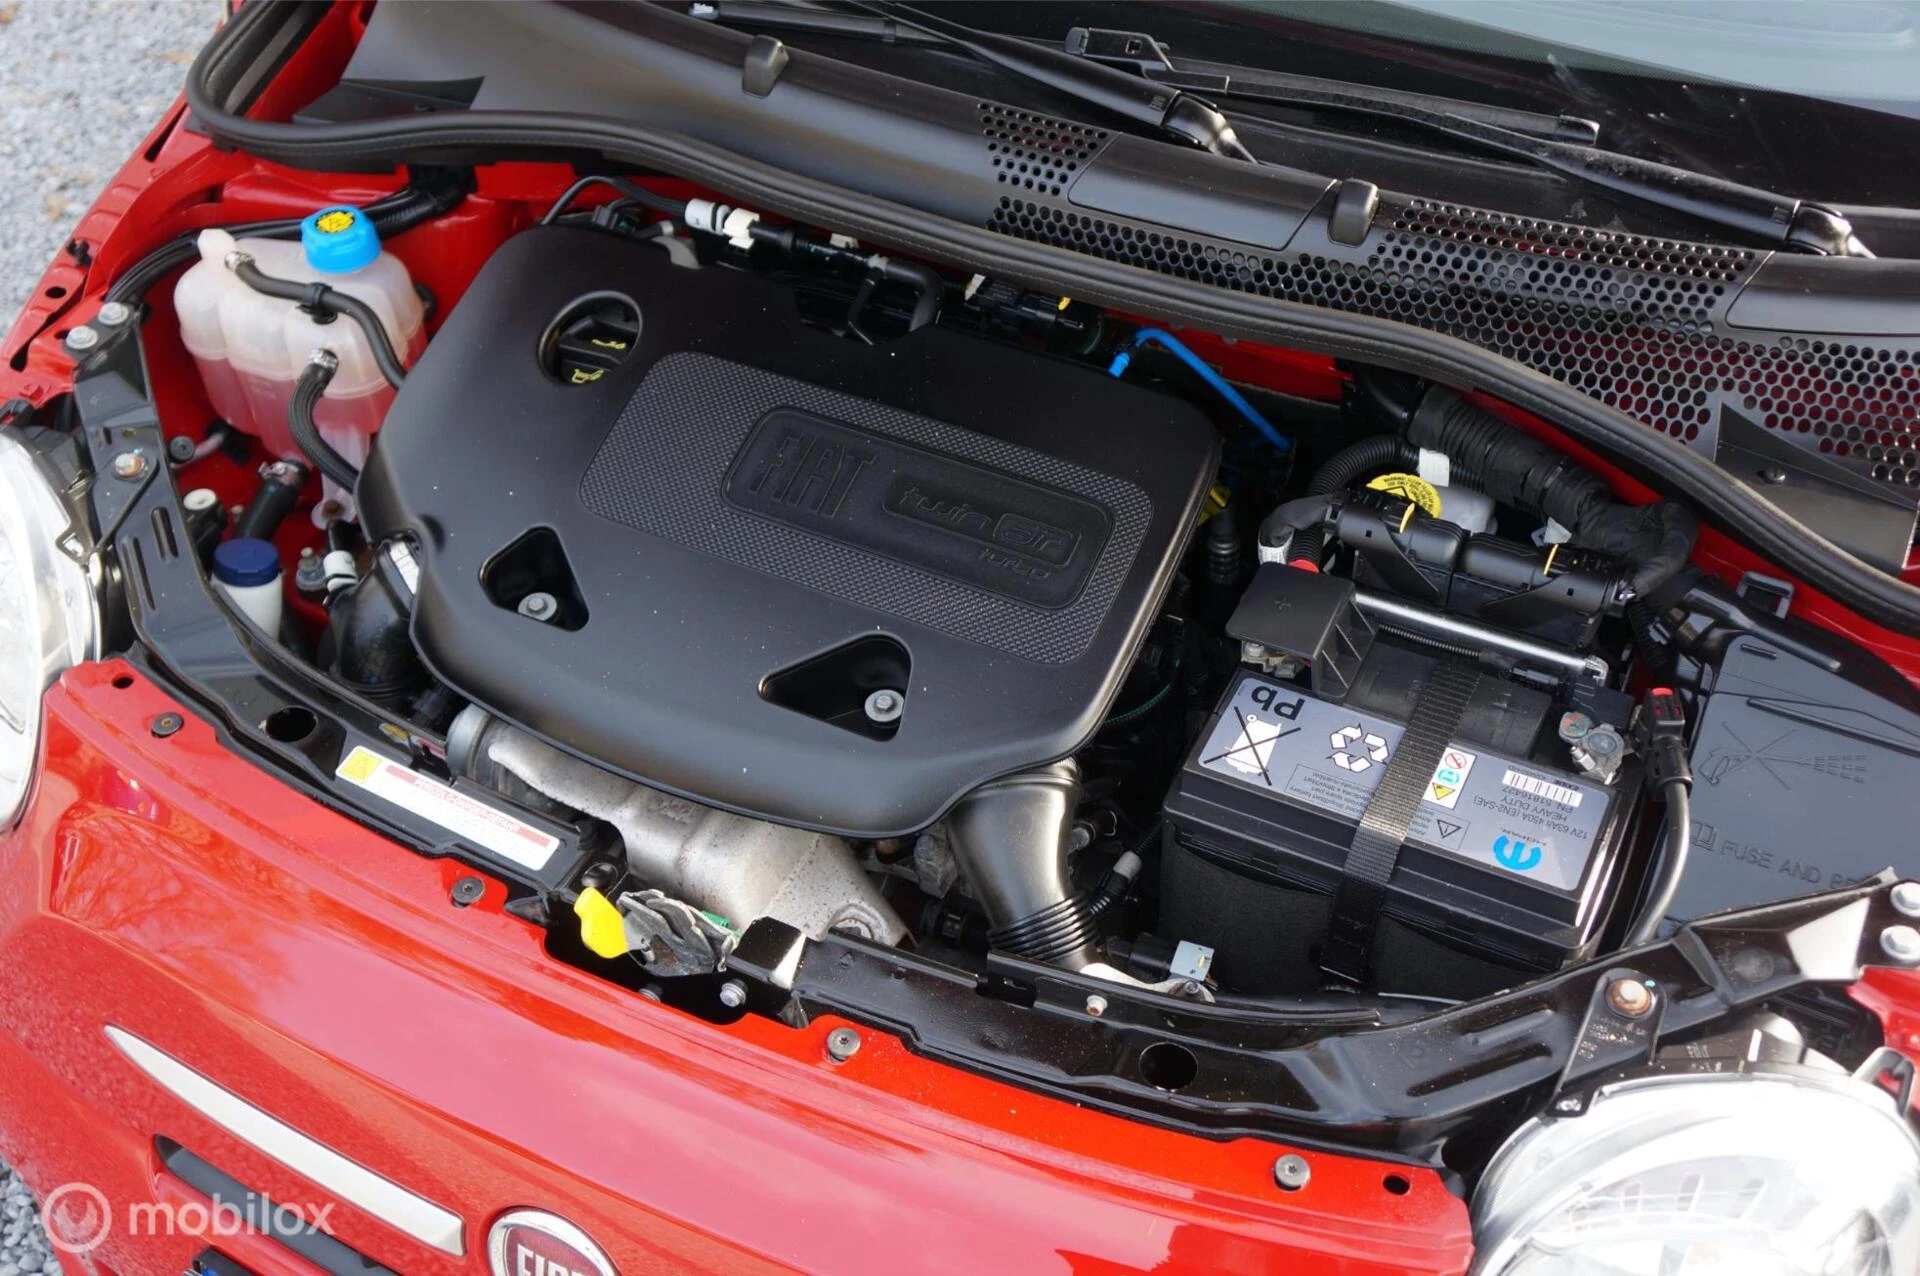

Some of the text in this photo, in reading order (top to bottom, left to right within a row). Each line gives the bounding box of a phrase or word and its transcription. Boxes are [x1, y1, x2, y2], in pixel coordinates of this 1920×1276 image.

[750, 429, 876, 518] FIAT
[1251, 685, 1306, 721] Pb
[1473, 794, 1588, 839] 12V 63Ah 450A (EN2-SAE)
[1500, 796, 1568, 822] HEAVY DUTY
[1721, 840, 1774, 869] FUSE
[1779, 859, 1821, 884] AND
[517, 1244, 585, 1276] FI
